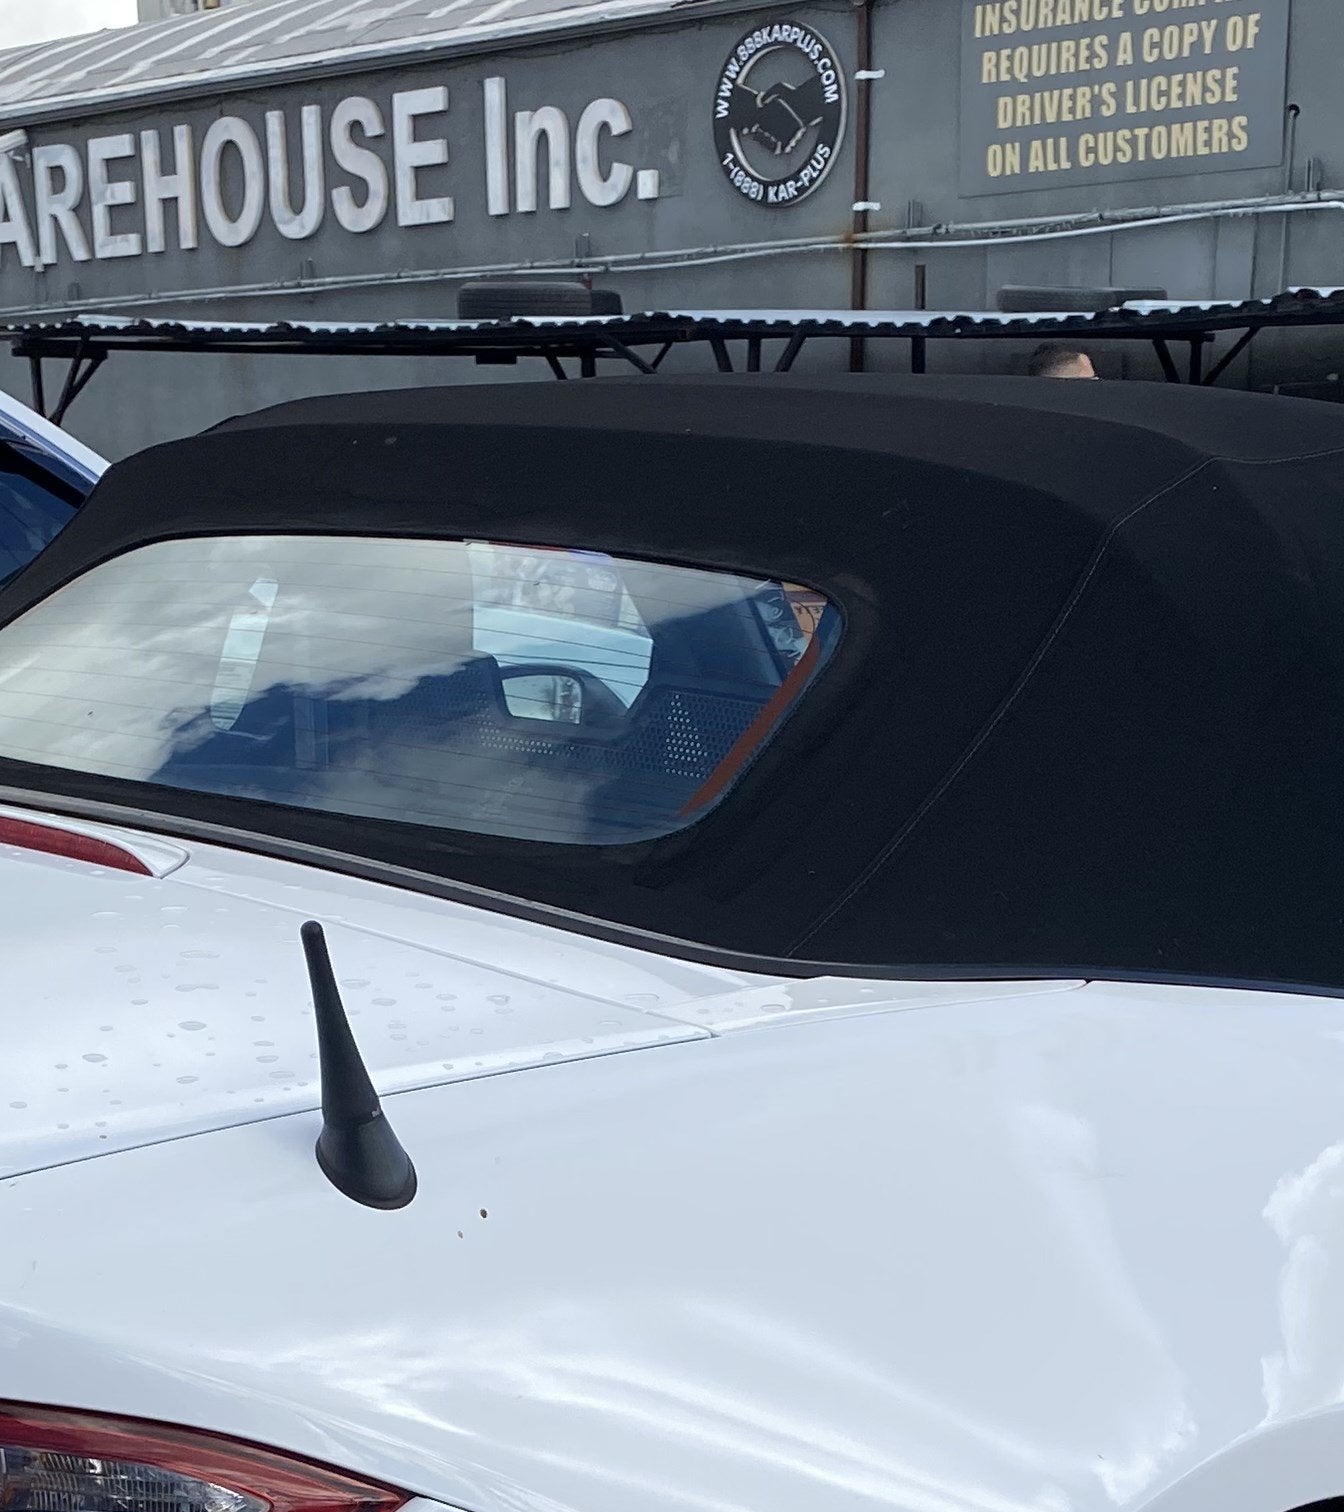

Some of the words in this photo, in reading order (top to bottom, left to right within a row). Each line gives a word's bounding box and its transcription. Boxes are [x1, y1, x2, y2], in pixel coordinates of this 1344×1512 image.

[974, 0, 1124, 38] INSURANCE
[981, 34, 1109, 84] REQUIRES
[1116, 31, 1134, 67] A
[1142, 19, 1218, 64] COPY
[1226, 13, 1261, 52] OF
[715, 24, 840, 119] WWW.888KARPLUS.COM
[996, 81, 1117, 129] DRIVER'S
[1125, 66, 1240, 114] LICENSE
[482, 75, 661, 217] Inc.
[767, 143, 831, 204] KAR-PLUS
[986, 142, 1021, 178] ON
[1028, 136, 1072, 174] ALL
[1078, 115, 1249, 168] CUSTOMERS
